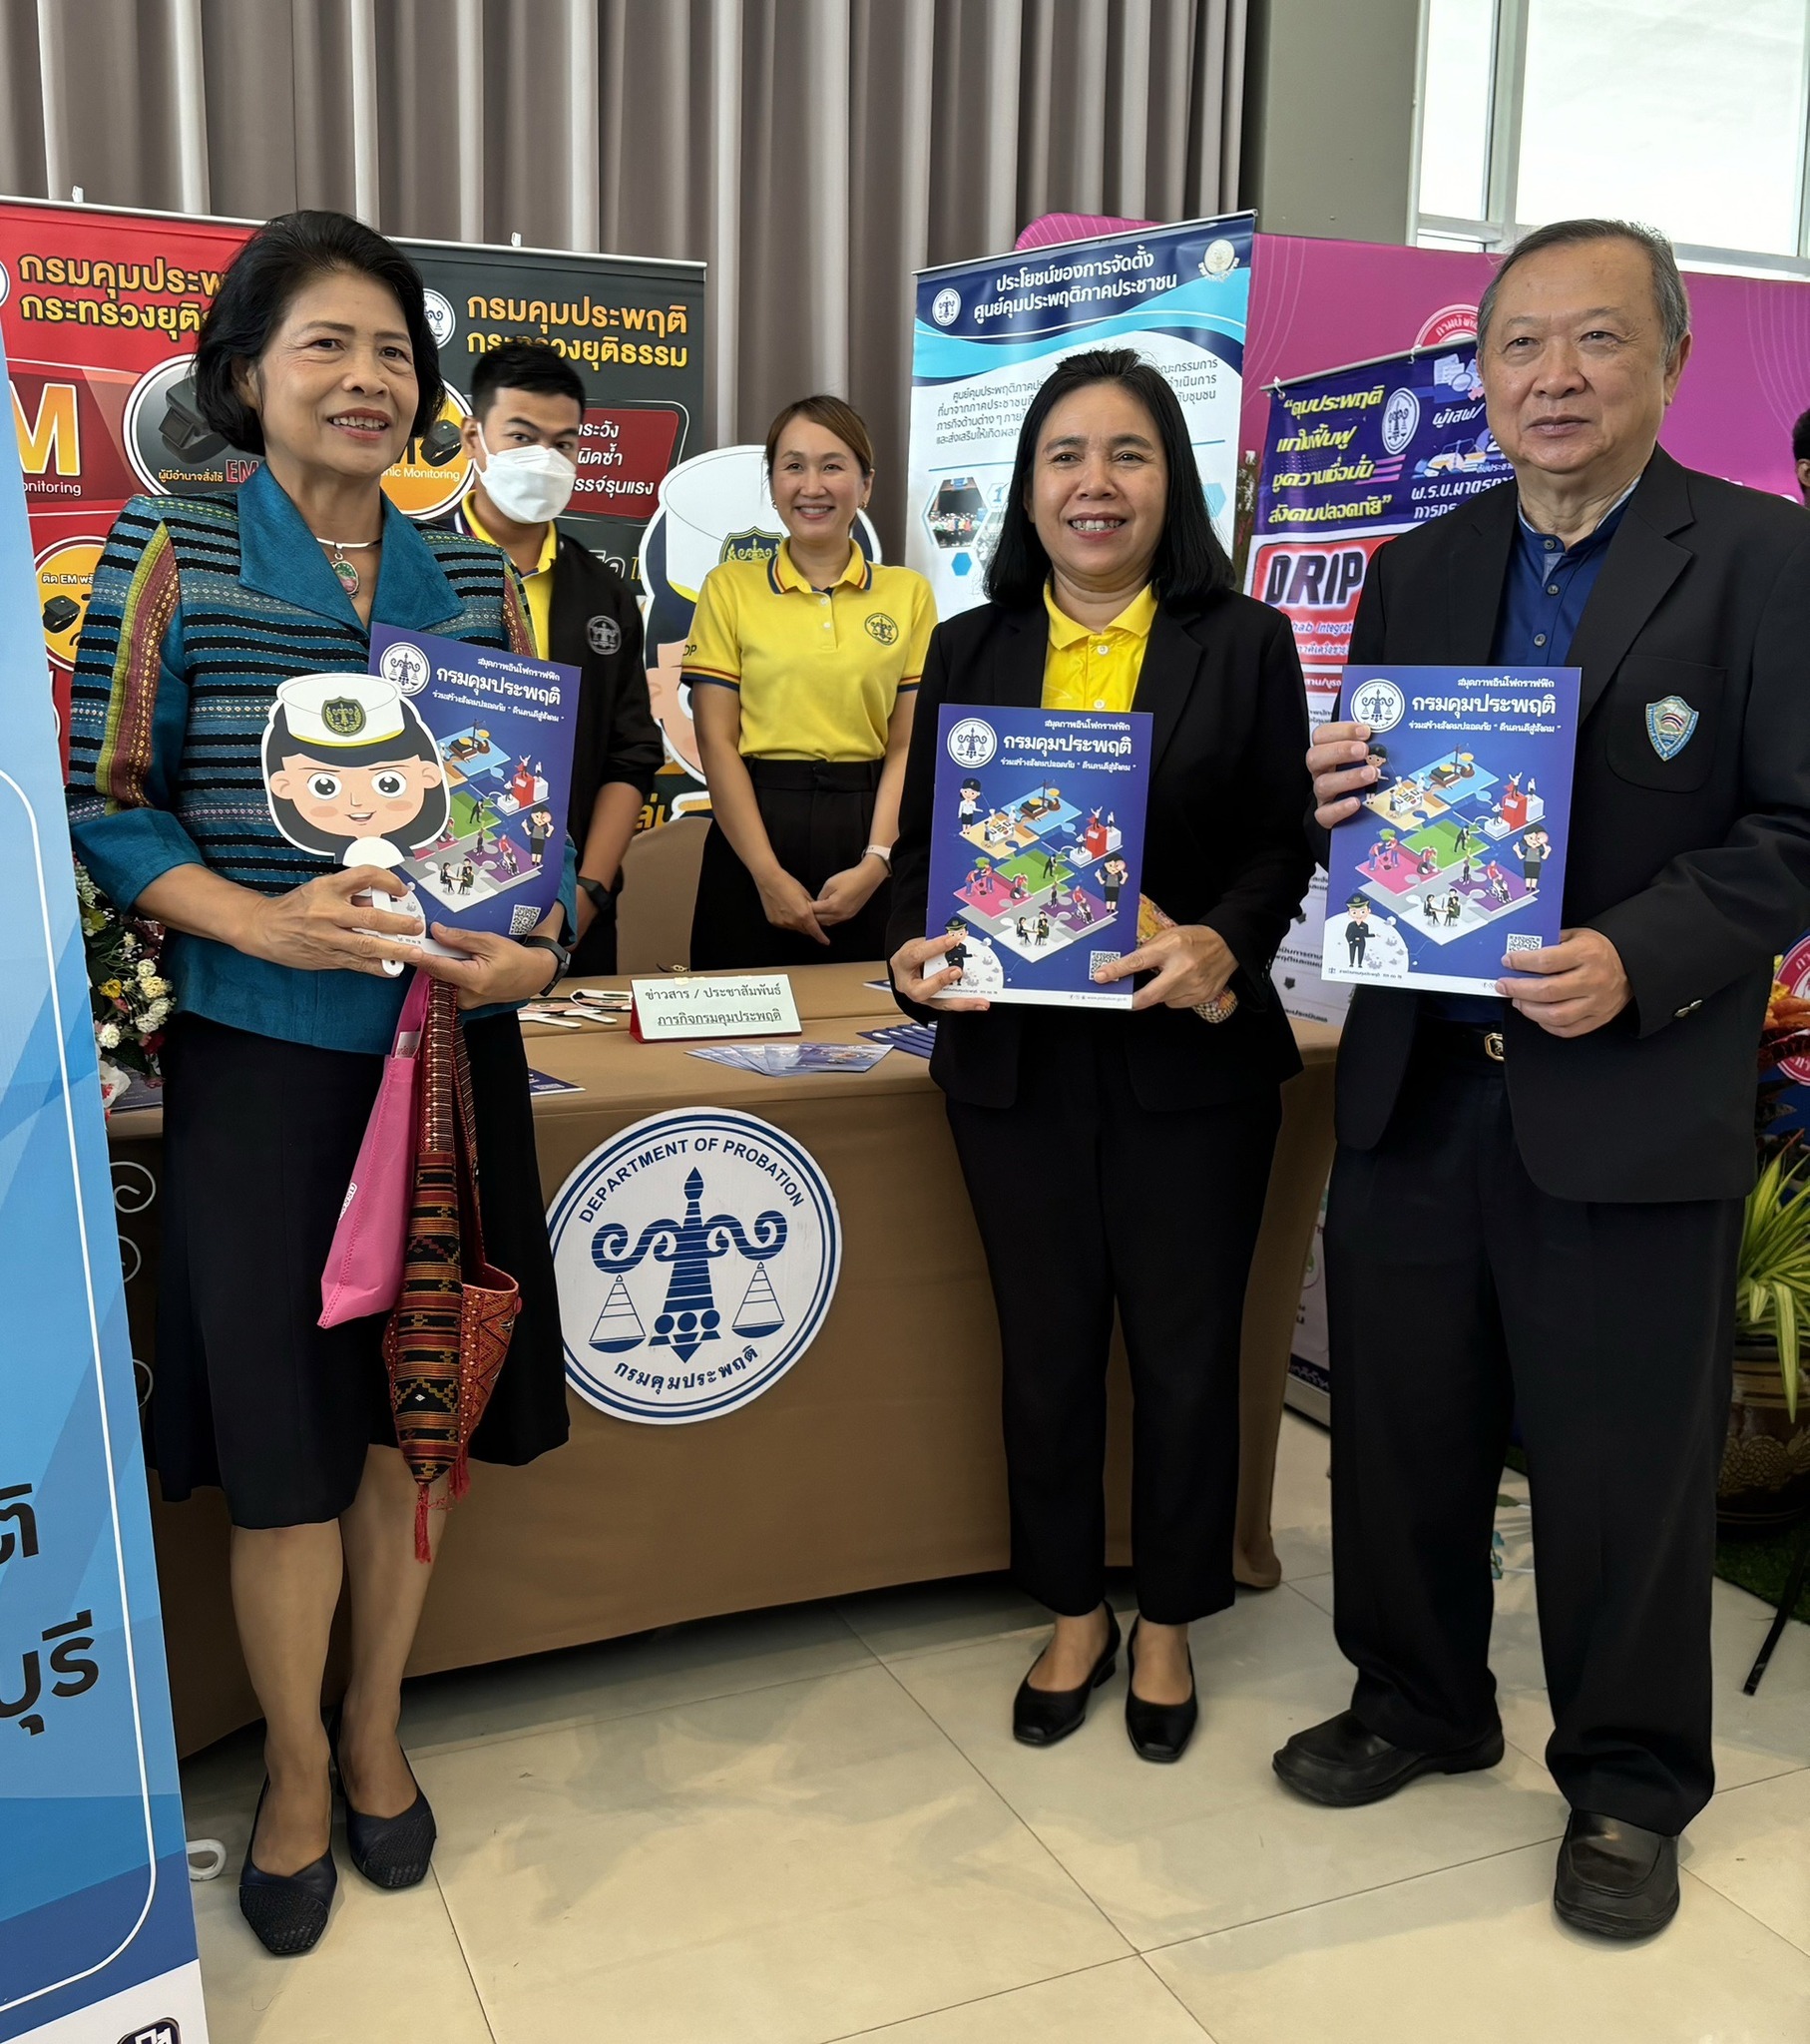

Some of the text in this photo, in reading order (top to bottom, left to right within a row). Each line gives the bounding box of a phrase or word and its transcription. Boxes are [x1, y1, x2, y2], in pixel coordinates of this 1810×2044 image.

[996, 245, 1154, 293] ประโยชน์ของการจัดตั้ง
[974, 272, 1177, 324] ศูนย์คุมประพฤติภาคประชาชน
[22, 294, 208, 341] กระทรวงยุติ
[467, 295, 687, 338] กรมคุมประพฤติ
[467, 331, 687, 371] กรวงยุติธรรม
[158, 458, 259, 484] ผู้มีอำนาจสั่งใช้ EM
[577, 442, 624, 466] ผิดซ้ำ
[403, 467, 460, 483] Monitoring
[1272, 454, 1375, 493] ชูความเชื่อมั่น
[1411, 475, 1516, 500] พ.ร.บ.มาตร
[1268, 493, 1393, 524] สังคมปลอดภัย”
[60, 574, 79, 585] EM
[1263, 549, 1365, 607] DRIP
[436, 668, 562, 706] กรมคุมประพฤติ
[1412, 694, 1557, 719] กรมคุมประพฤติ
[1003, 734, 1132, 758] กรมคุมประพฤติ
[646, 988, 690, 1001] ข่าวสาร
[703, 982, 782, 998] ประชาสัมพันธ์
[658, 1007, 782, 1027] ภารกิจกรมคุมประพฤติ
[578, 1137, 805, 1224] DEPARTMENT OF PROBATION
[614, 1344, 760, 1395] กรมคุมประพฤติ
